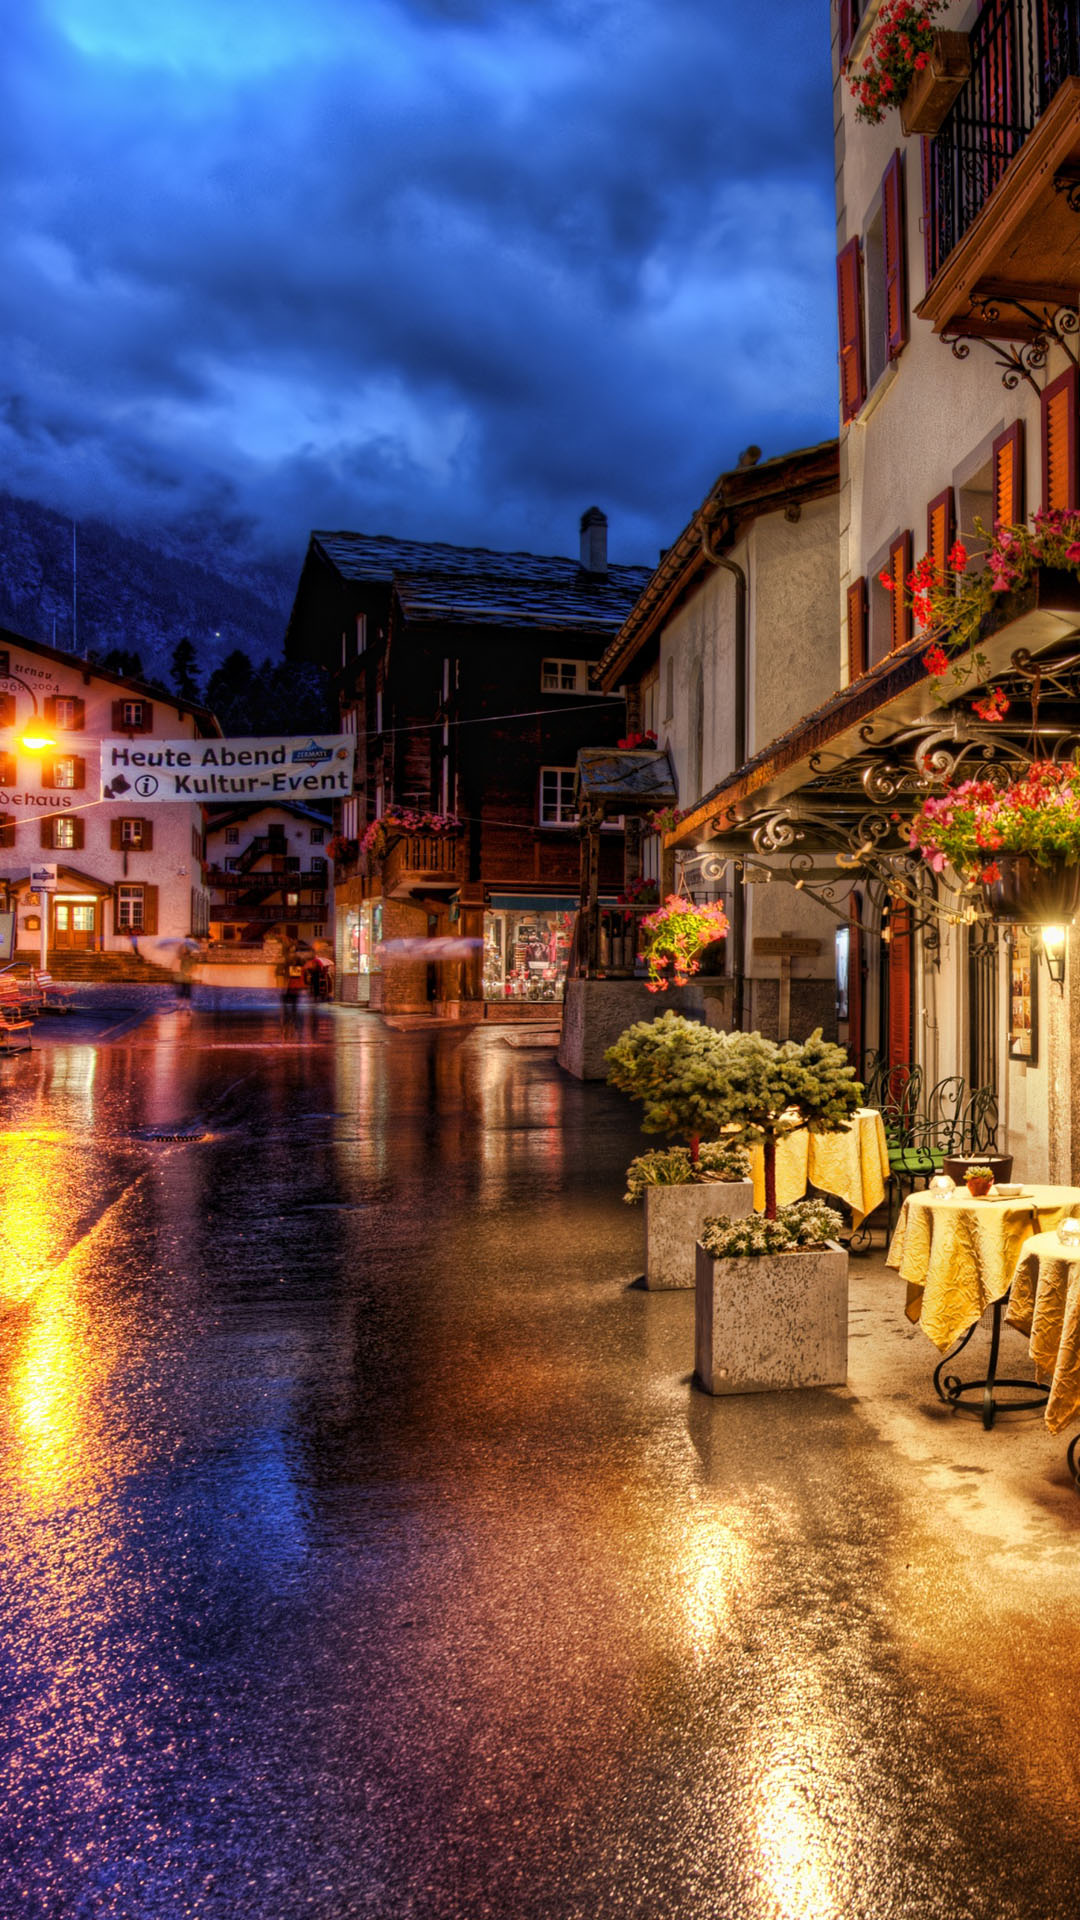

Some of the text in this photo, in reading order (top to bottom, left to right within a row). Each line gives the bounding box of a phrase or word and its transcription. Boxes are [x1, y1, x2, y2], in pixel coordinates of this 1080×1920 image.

[32, 683, 60, 694] 2004
[111, 745, 286, 767] Heute Abend
[175, 771, 348, 794] Kultur-Event
